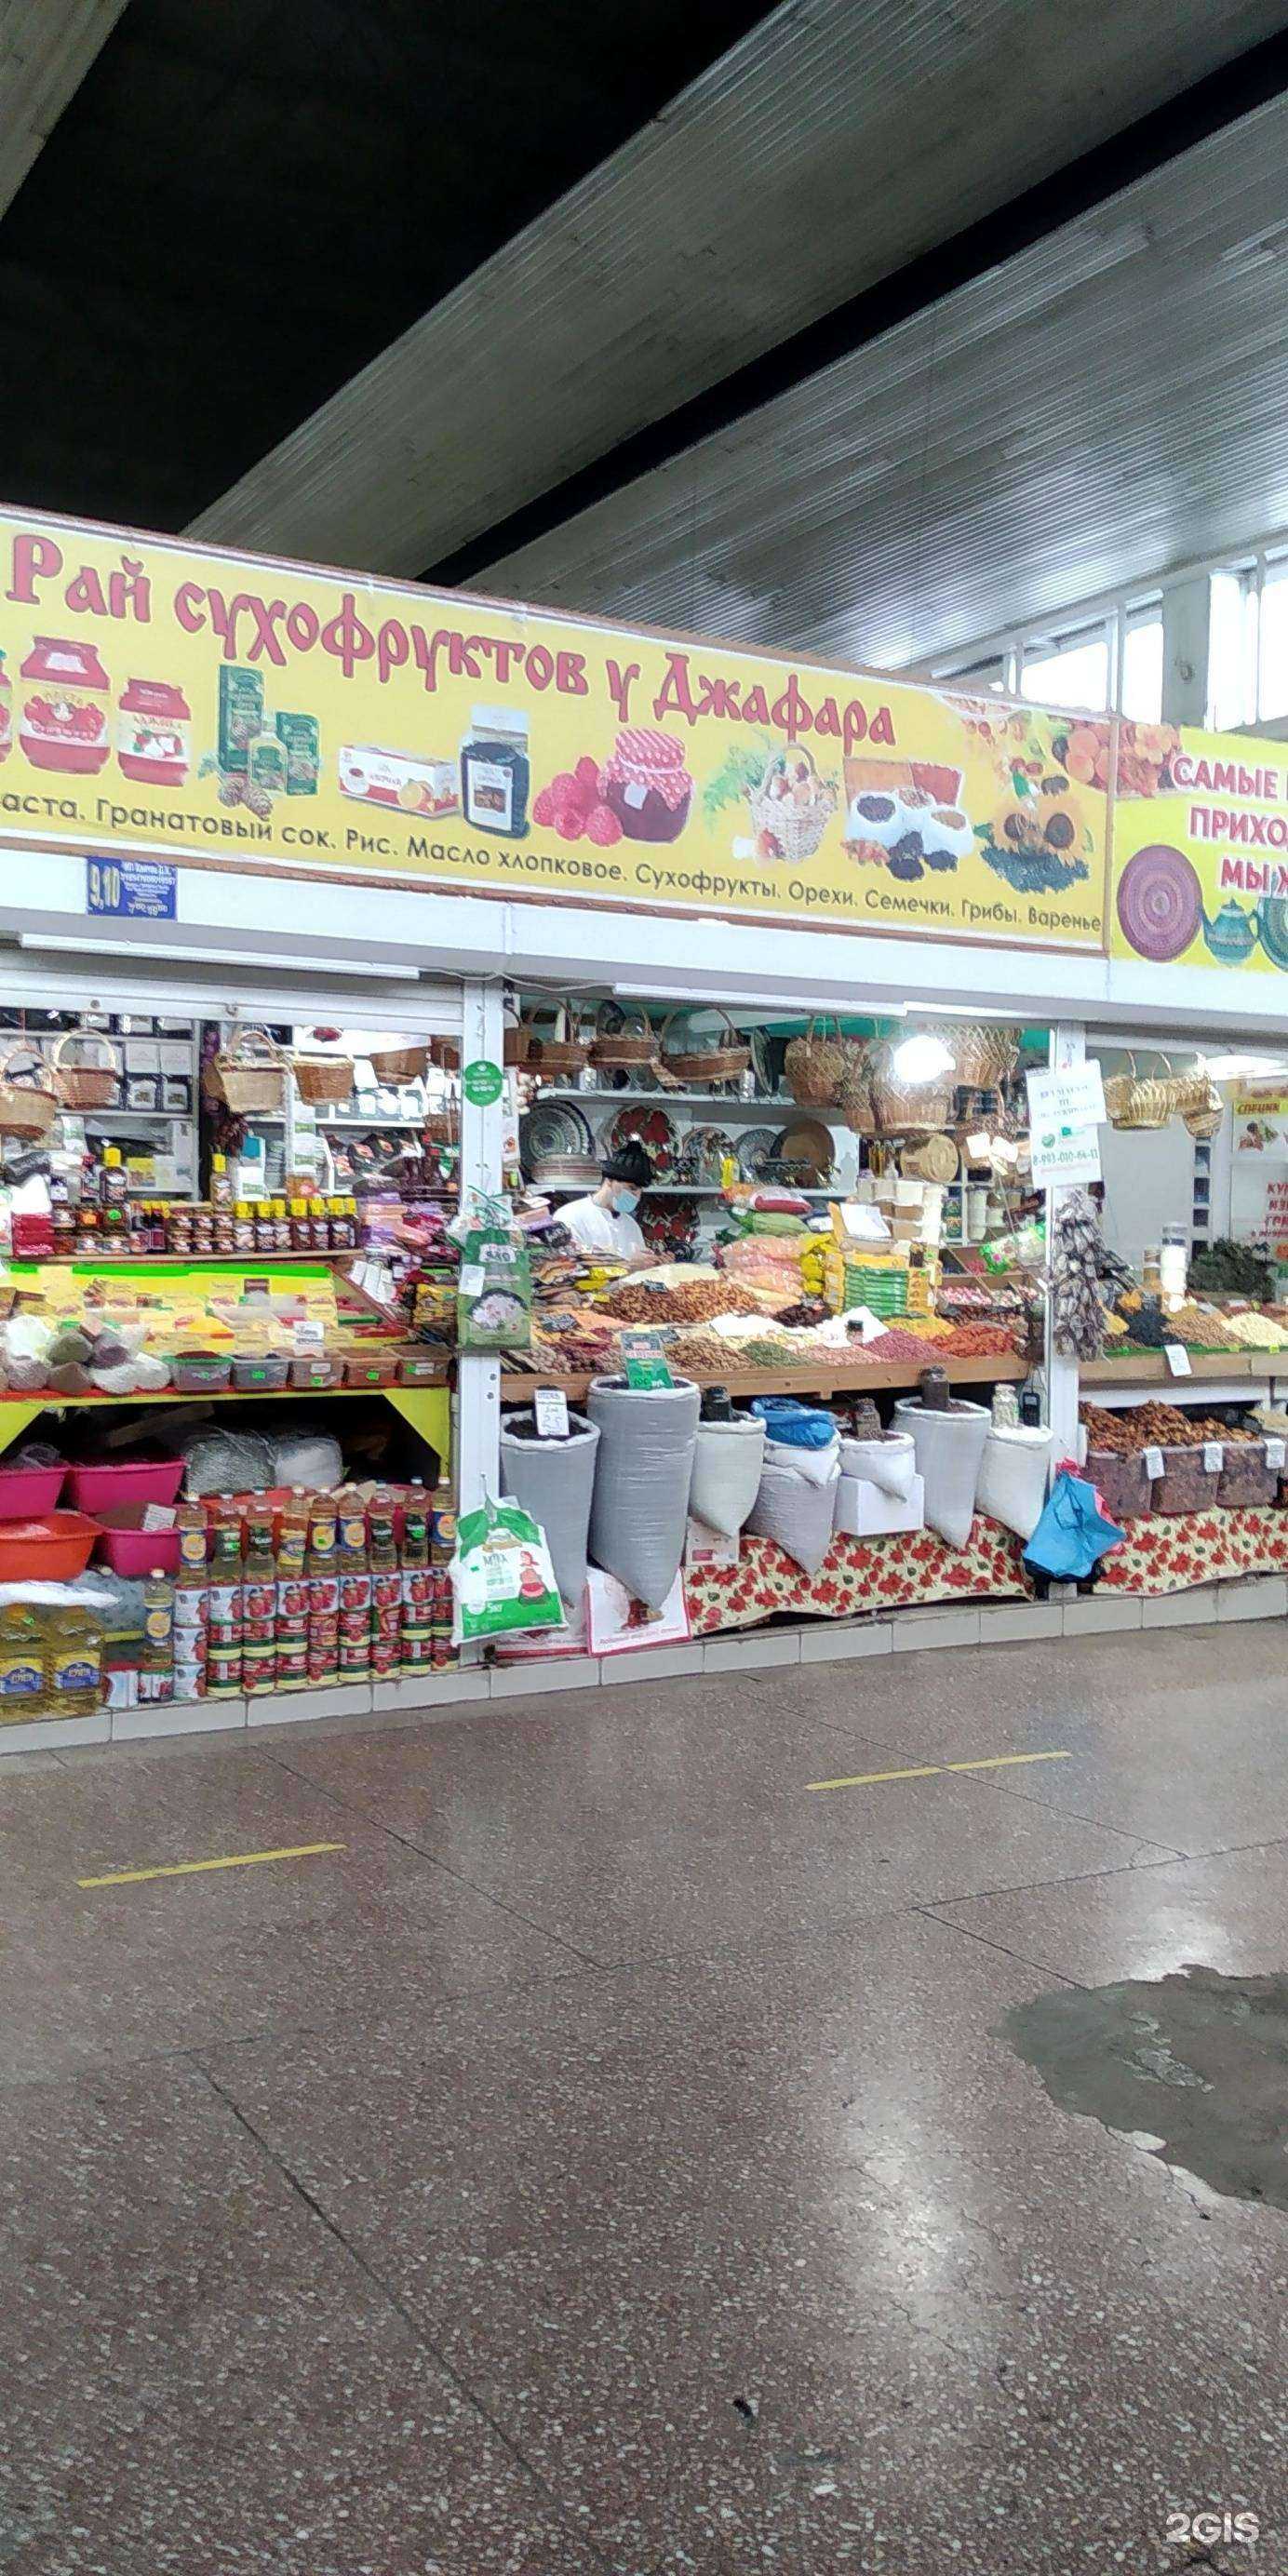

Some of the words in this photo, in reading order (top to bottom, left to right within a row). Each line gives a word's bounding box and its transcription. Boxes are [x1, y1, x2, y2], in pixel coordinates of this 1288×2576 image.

[6, 534, 152, 624] Рай
[174, 581, 590, 696] сухофруктов
[606, 659, 641, 723] у
[652, 652, 896, 757] Джафара
[1173, 757, 1279, 799] САМЫЕ
[1189, 806, 1288, 846] ПРИХО
[96, 798, 273, 842] Гранатовый
[282, 826, 337, 850] сок.
[346, 828, 398, 855] Рис.
[407, 835, 490, 865] Масло
[498, 851, 627, 882] хлопковое.
[636, 862, 782, 899] Сухофрукты.
[788, 879, 858, 906] Орехи.
[865, 889, 956, 918] Семечки.
[961, 899, 1022, 922] Грибы.
[1028, 906, 1102, 932] Варенье
[1220, 858, 1270, 892] МЫ
